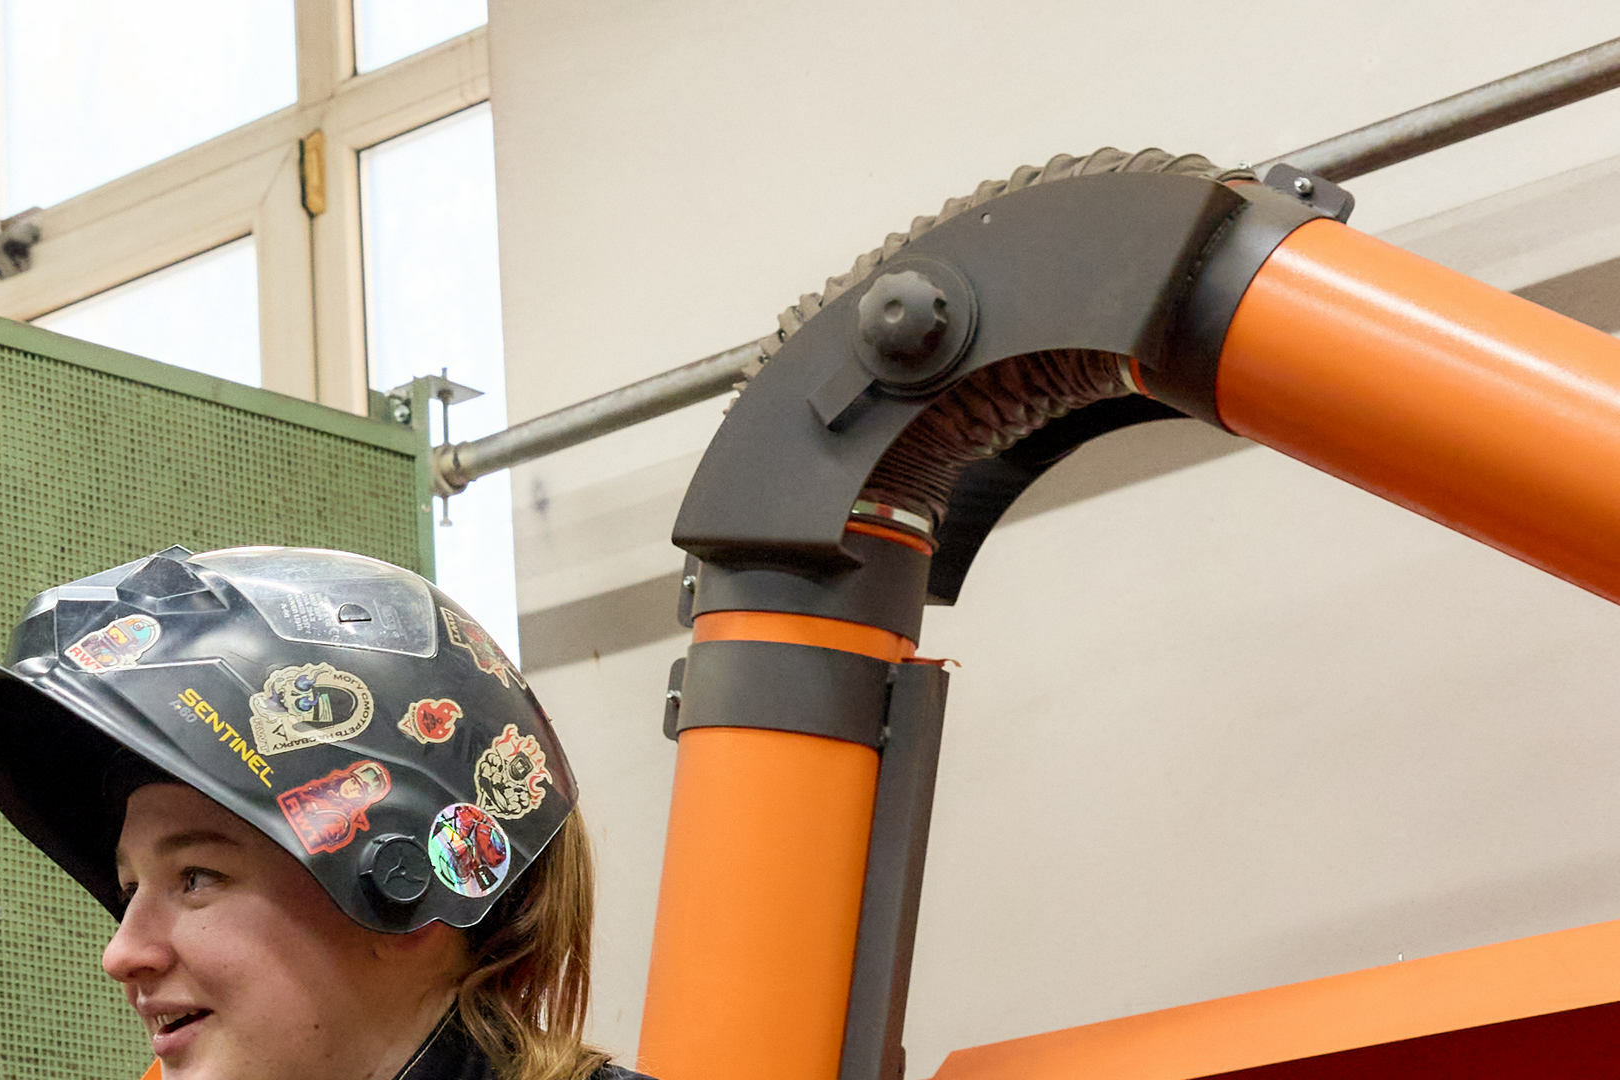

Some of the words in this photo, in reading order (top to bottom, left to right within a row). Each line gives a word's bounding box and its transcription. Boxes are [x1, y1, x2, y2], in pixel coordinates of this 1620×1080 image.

[332, 674, 363, 690] МОГУ
[178, 688, 274, 788] SENTINEL
[335, 692, 370, 737] СМОТРЕТЬ
[283, 796, 322, 845] RWT
